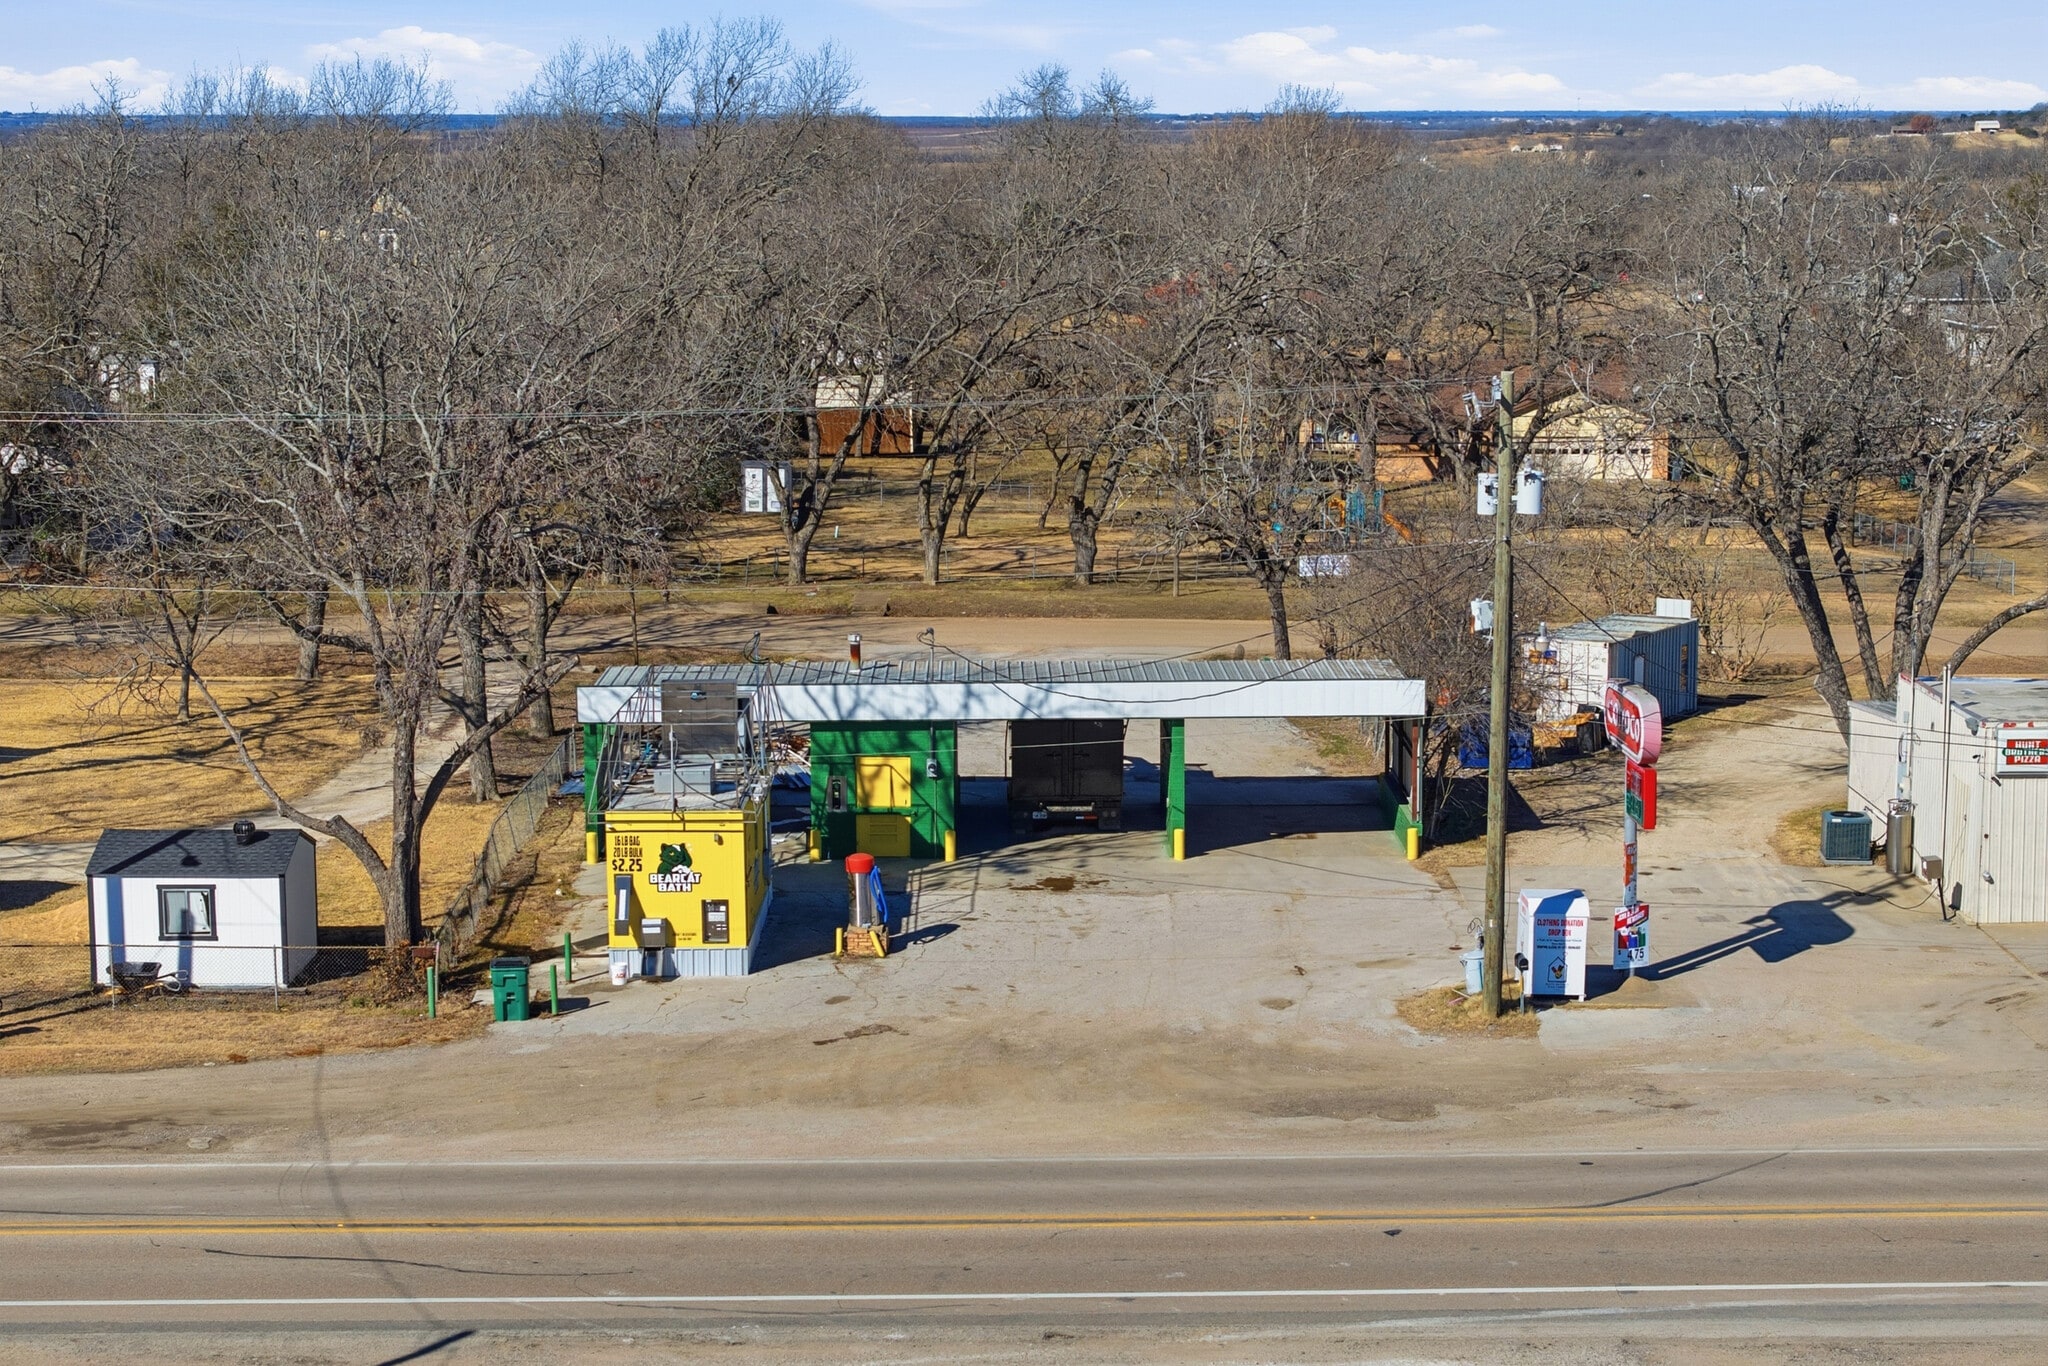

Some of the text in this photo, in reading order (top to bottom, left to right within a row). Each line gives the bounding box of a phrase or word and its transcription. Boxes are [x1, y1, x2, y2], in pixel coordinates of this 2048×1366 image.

[2015, 740, 2041, 748] HUNT
[2014, 755, 2041, 763] PIZZA
[629, 835, 640, 846] BAG
[613, 847, 621, 857] 20
[629, 847, 643, 857] BULK
[612, 858, 642, 872] $2.25
[649, 873, 701, 883] BEARCAT
[658, 883, 692, 892] BATH
[1537, 918, 1584, 927] CLOTHING DONATION
[1548, 928, 1572, 937] DROP BOX
